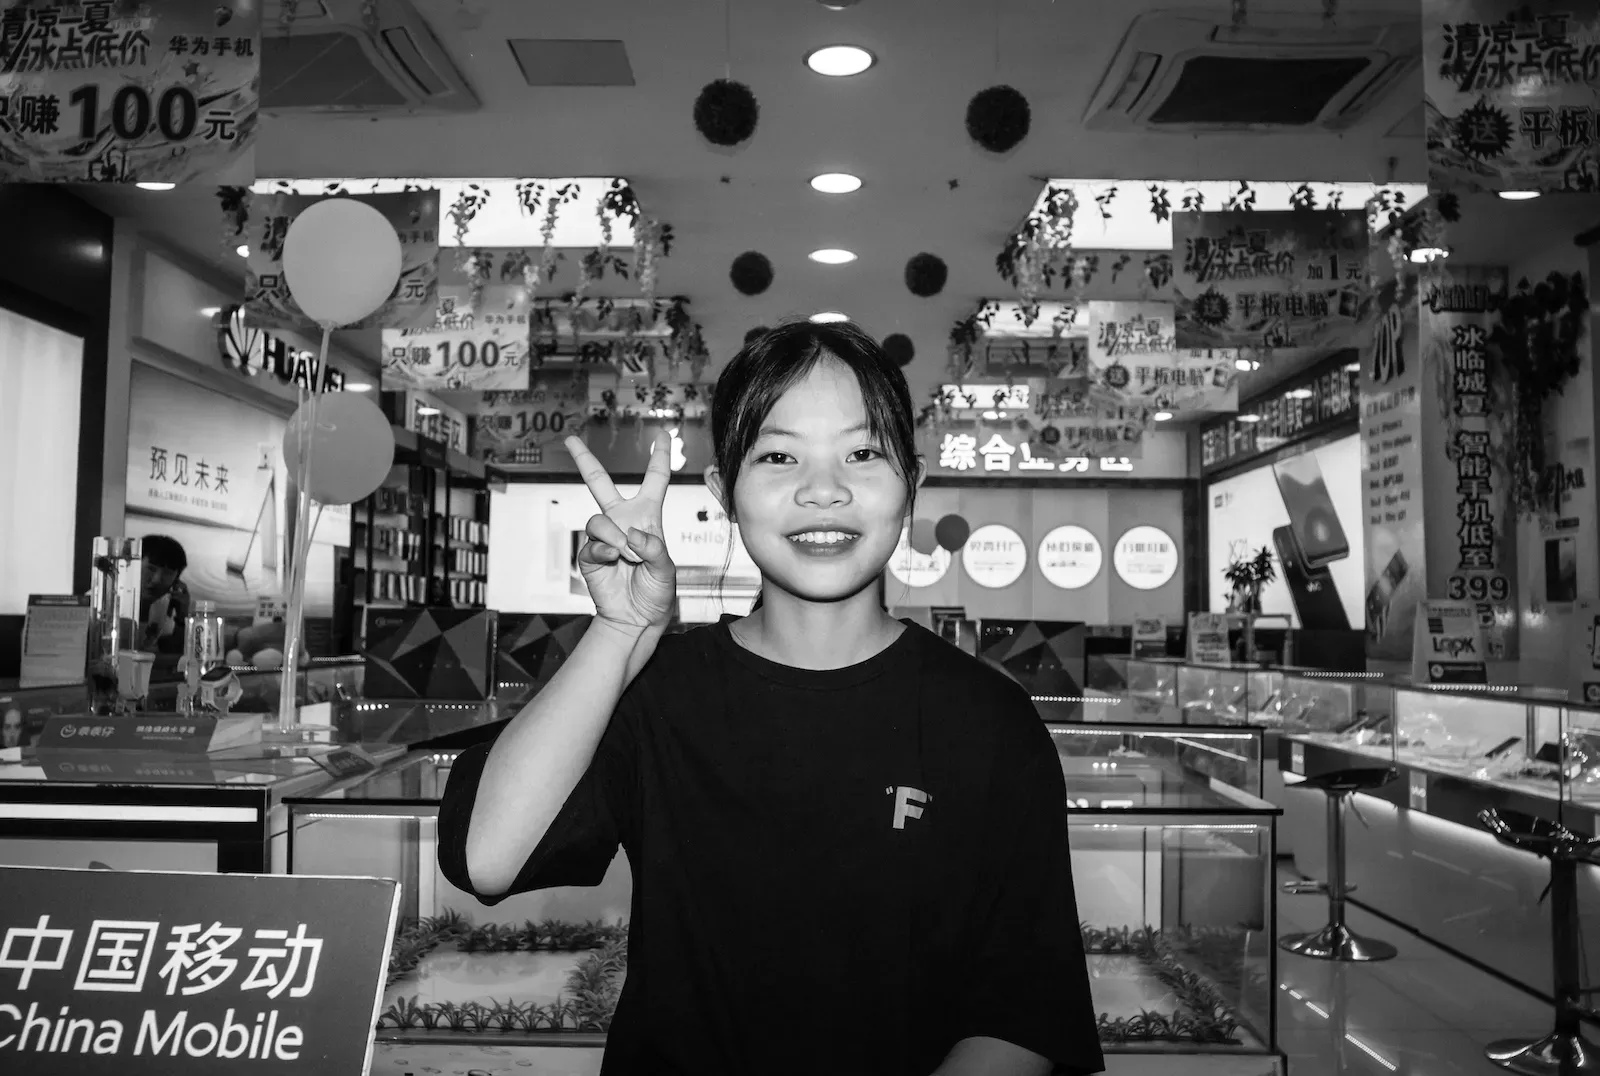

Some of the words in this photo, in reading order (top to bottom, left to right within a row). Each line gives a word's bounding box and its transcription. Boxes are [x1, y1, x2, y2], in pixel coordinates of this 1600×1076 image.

[15, 27, 150, 72] 冰点低价
[168, 35, 254, 58] 华为手机
[1441, 12, 1573, 59] 清凉一夏
[1520, 106, 1600, 148] 平板
[1236, 292, 1329, 318] 平板电脑
[389, 339, 519, 368] 只赚100元
[149, 446, 229, 495] 预见未来
[1448, 576, 1509, 600] 399
[0, 914, 324, 1000] 中国移动
[133, 1008, 304, 1061] Mobile
